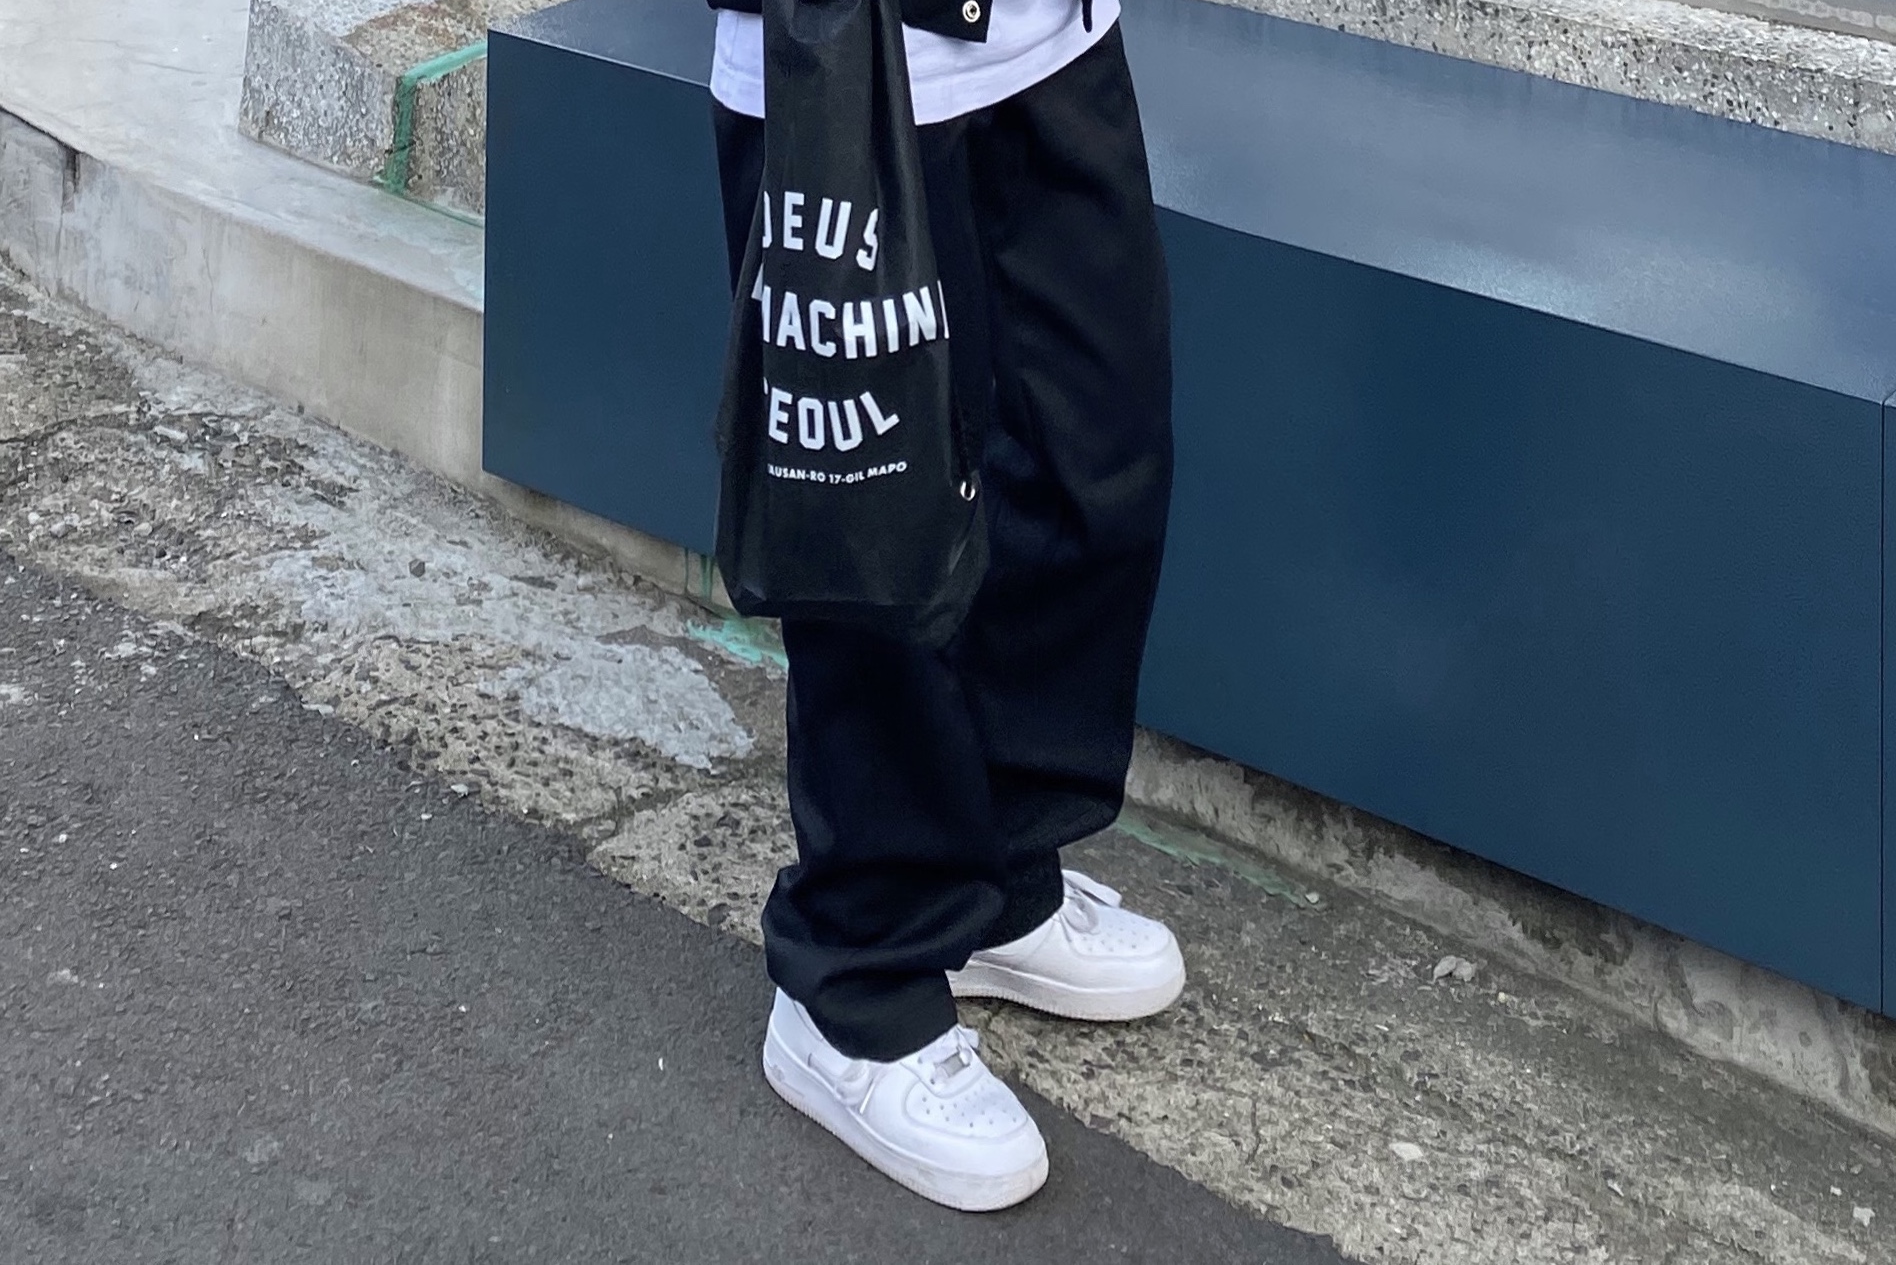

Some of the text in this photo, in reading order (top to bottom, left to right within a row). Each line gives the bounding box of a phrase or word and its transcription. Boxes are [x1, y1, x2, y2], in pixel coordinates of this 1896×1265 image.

[757, 278, 950, 360] ACHIN
[763, 377, 901, 453] EOUL
[768, 461, 907, 484] AUSAN-RO 17-GIL MAPO
